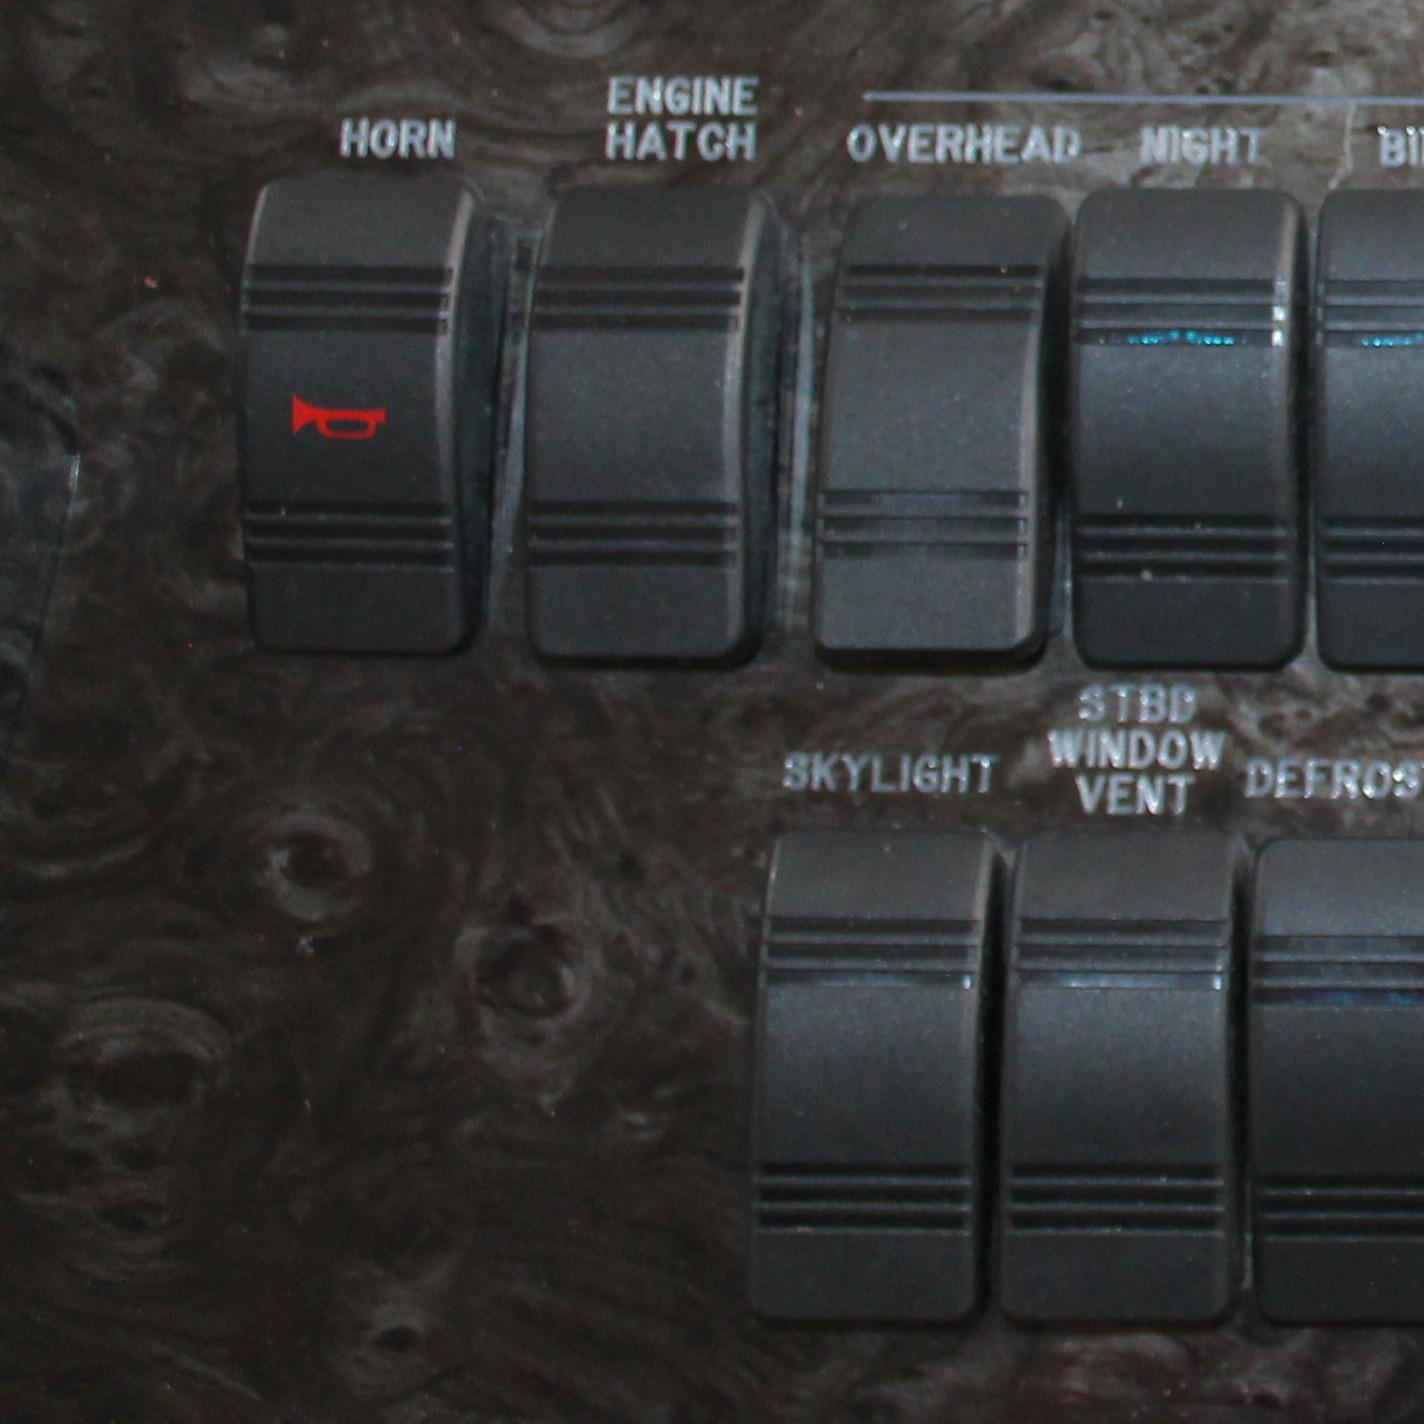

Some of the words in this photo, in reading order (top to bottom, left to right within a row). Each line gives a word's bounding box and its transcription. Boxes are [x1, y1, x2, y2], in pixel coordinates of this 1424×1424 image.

[607, 76, 759, 116] ENGINE
[340, 116, 457, 160] HORN
[605, 122, 758, 162] HATCH
[846, 122, 1084, 166] OVERHEAD
[1138, 125, 1268, 166] NIGHT
[1076, 683, 1197, 725] STBD
[1046, 728, 1228, 771] WINDOW
[781, 751, 999, 794] SKYLIGHT
[1075, 774, 1196, 816] VENT
